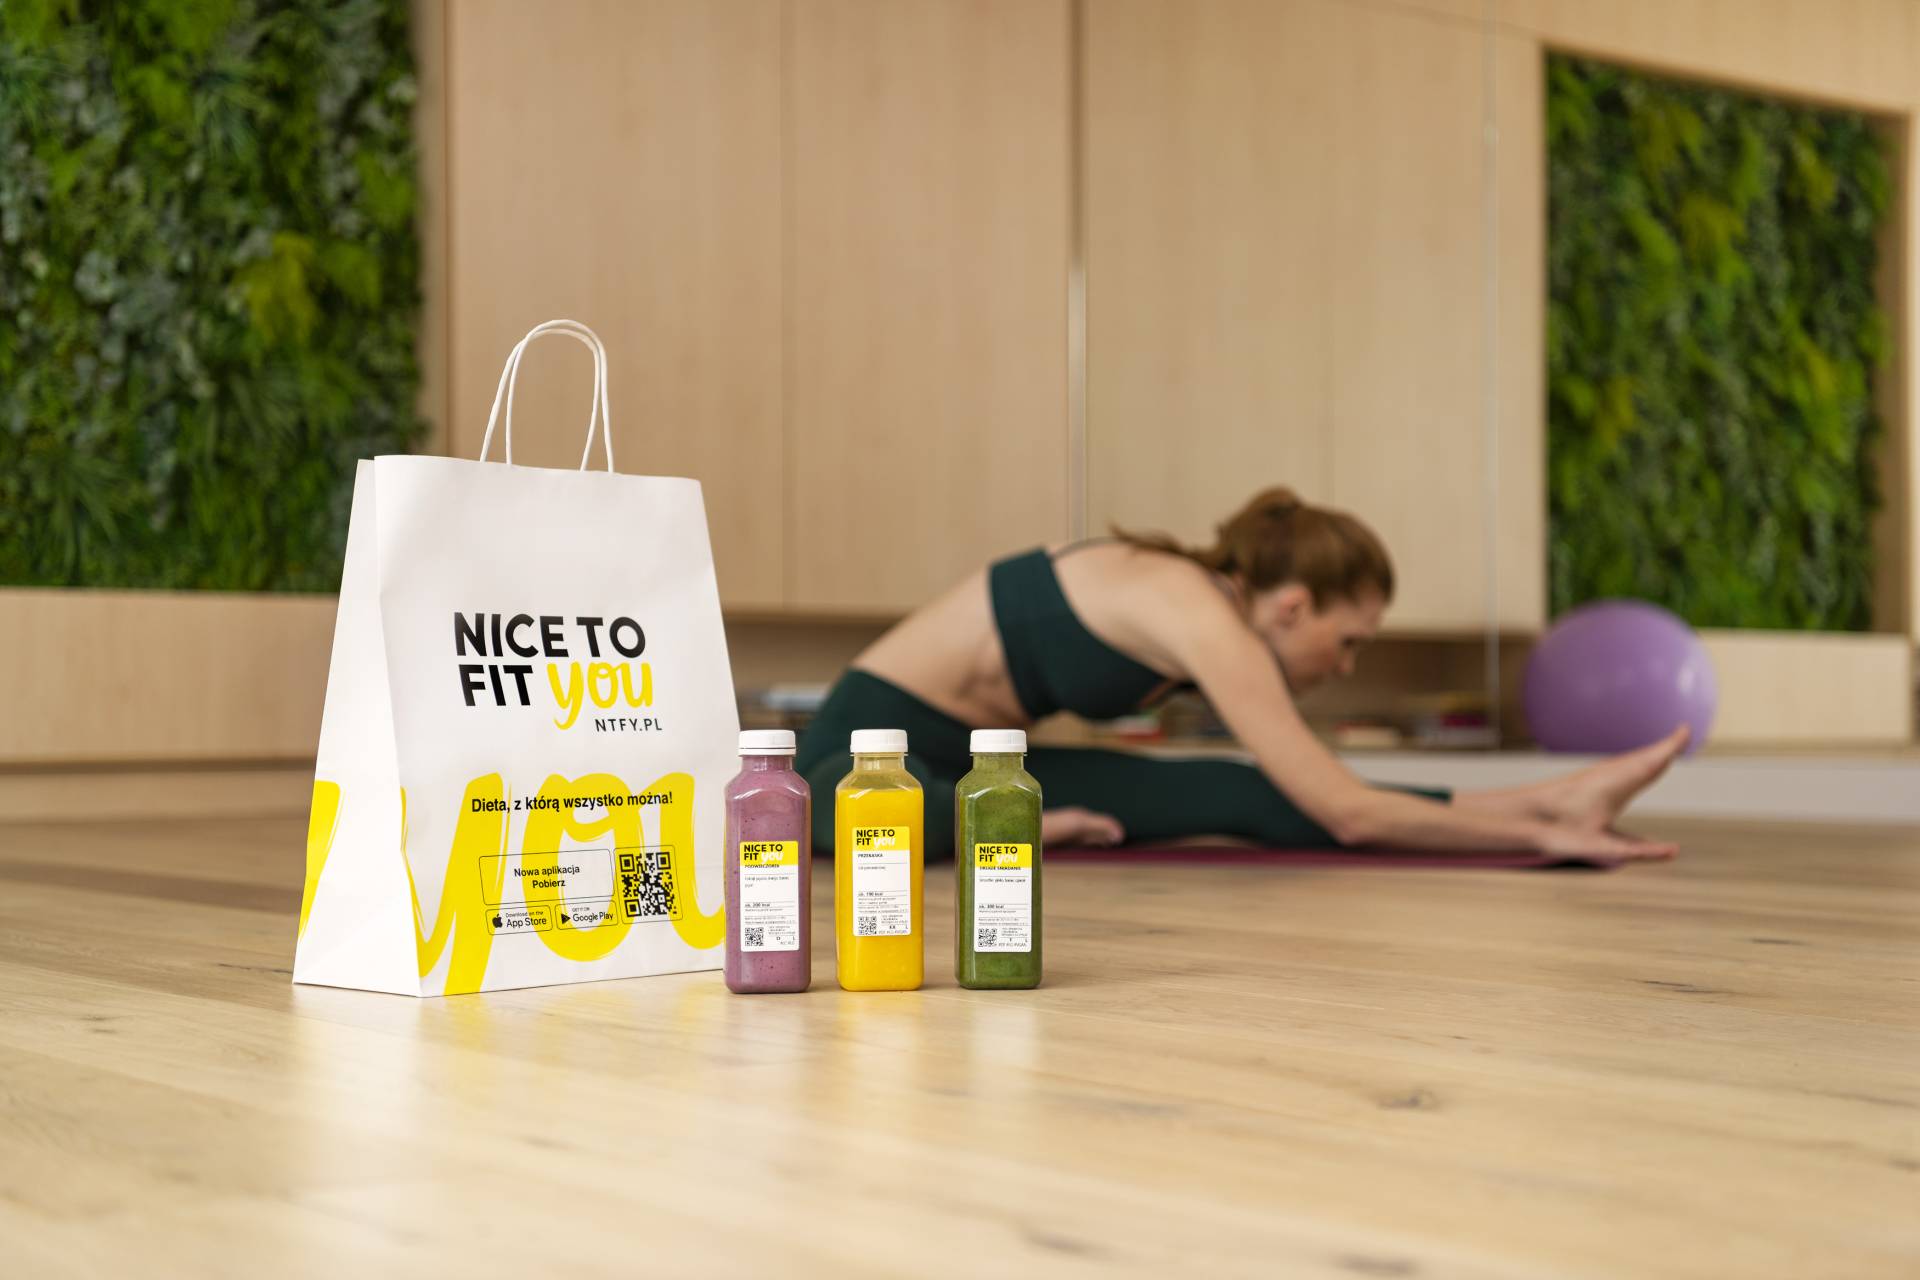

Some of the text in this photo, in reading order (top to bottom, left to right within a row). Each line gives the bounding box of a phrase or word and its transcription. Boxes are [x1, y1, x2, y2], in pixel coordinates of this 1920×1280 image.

[454, 612, 646, 658] NICE TO
[458, 661, 654, 731] FIT you
[594, 718, 663, 732] NTFY.PL
[471, 791, 673, 813] Dieta, z którą wszystko można!
[856, 829, 895, 838] NICE TO
[856, 838, 871, 846] FIT
[743, 844, 783, 852] NICE TO
[979, 846, 1018, 854] NICE TO
[743, 853, 759, 861] FIT
[979, 854, 994, 862] FIT
[513, 865, 580, 877] Nowa aplikacja
[532, 879, 566, 889] Pobierz
[506, 916, 547, 929] App Store
[572, 911, 614, 923] Google Play
